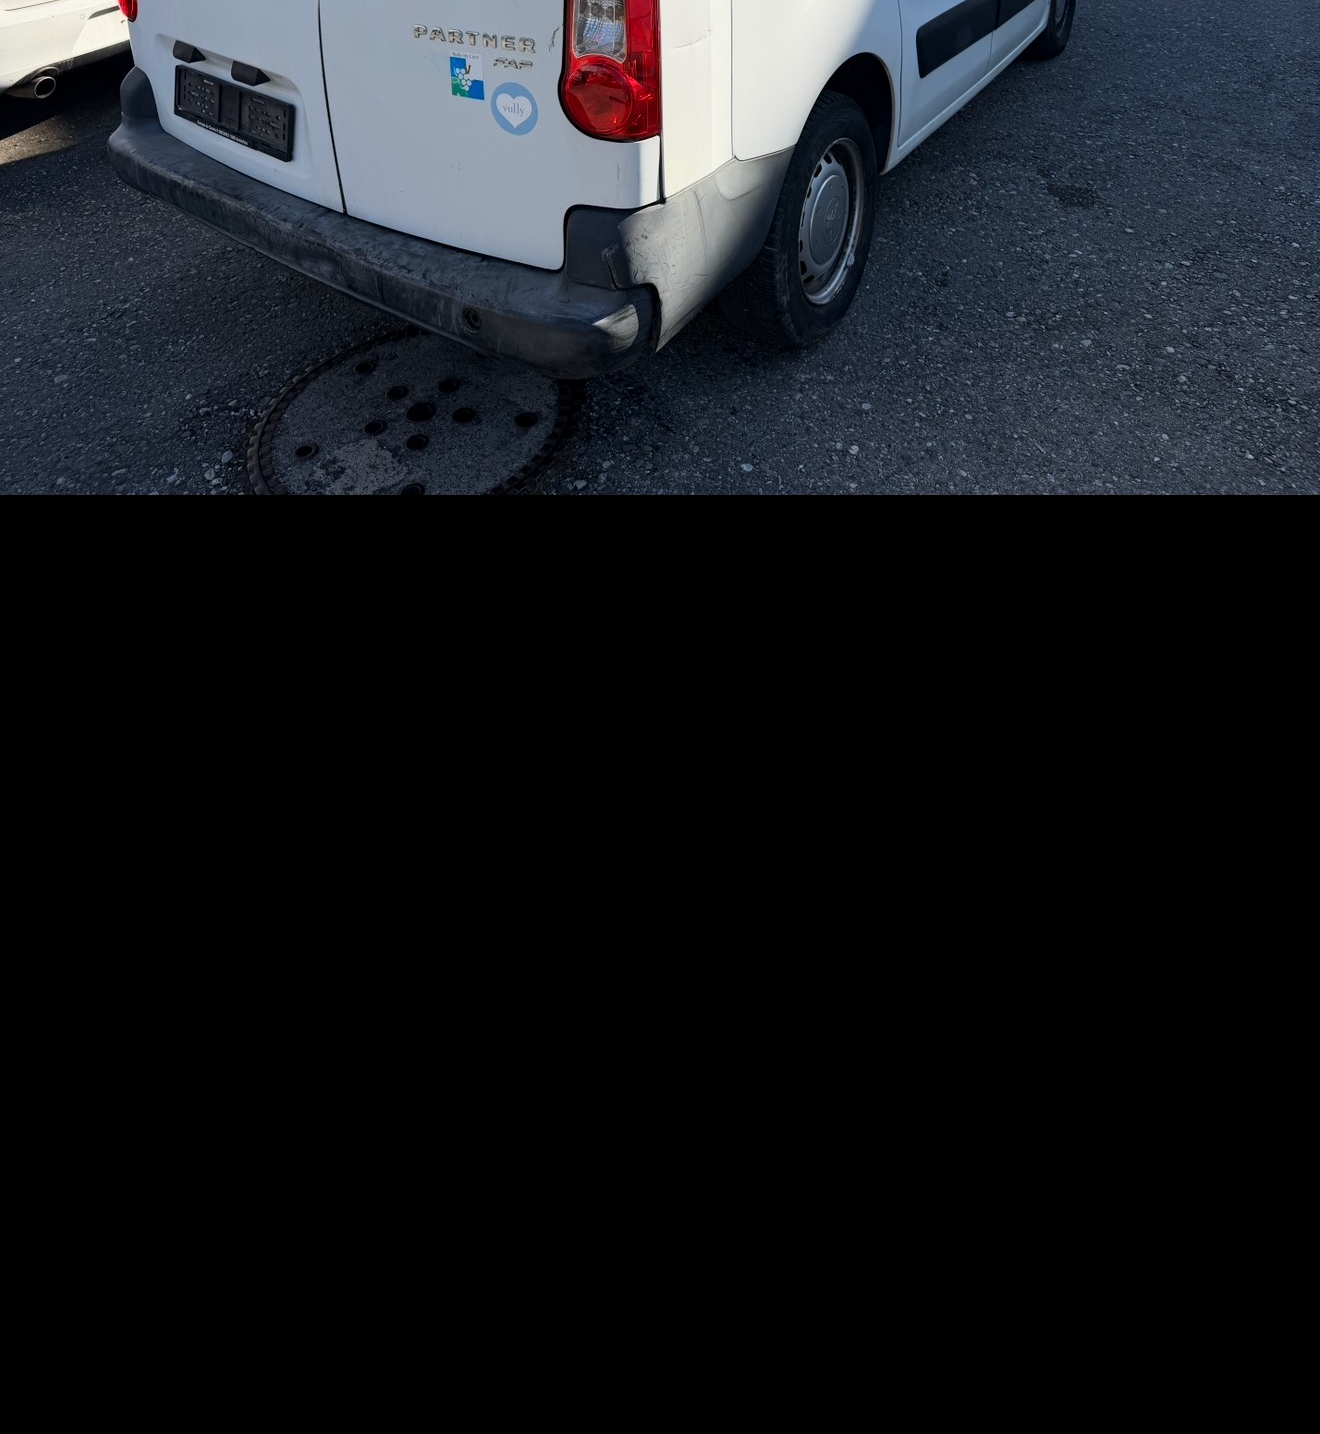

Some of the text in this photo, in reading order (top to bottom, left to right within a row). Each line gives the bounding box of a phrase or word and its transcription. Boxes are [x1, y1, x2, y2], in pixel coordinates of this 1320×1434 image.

[413, 24, 536, 54] PARTNER
[493, 57, 533, 69] FAP
[502, 103, 525, 118] vully
